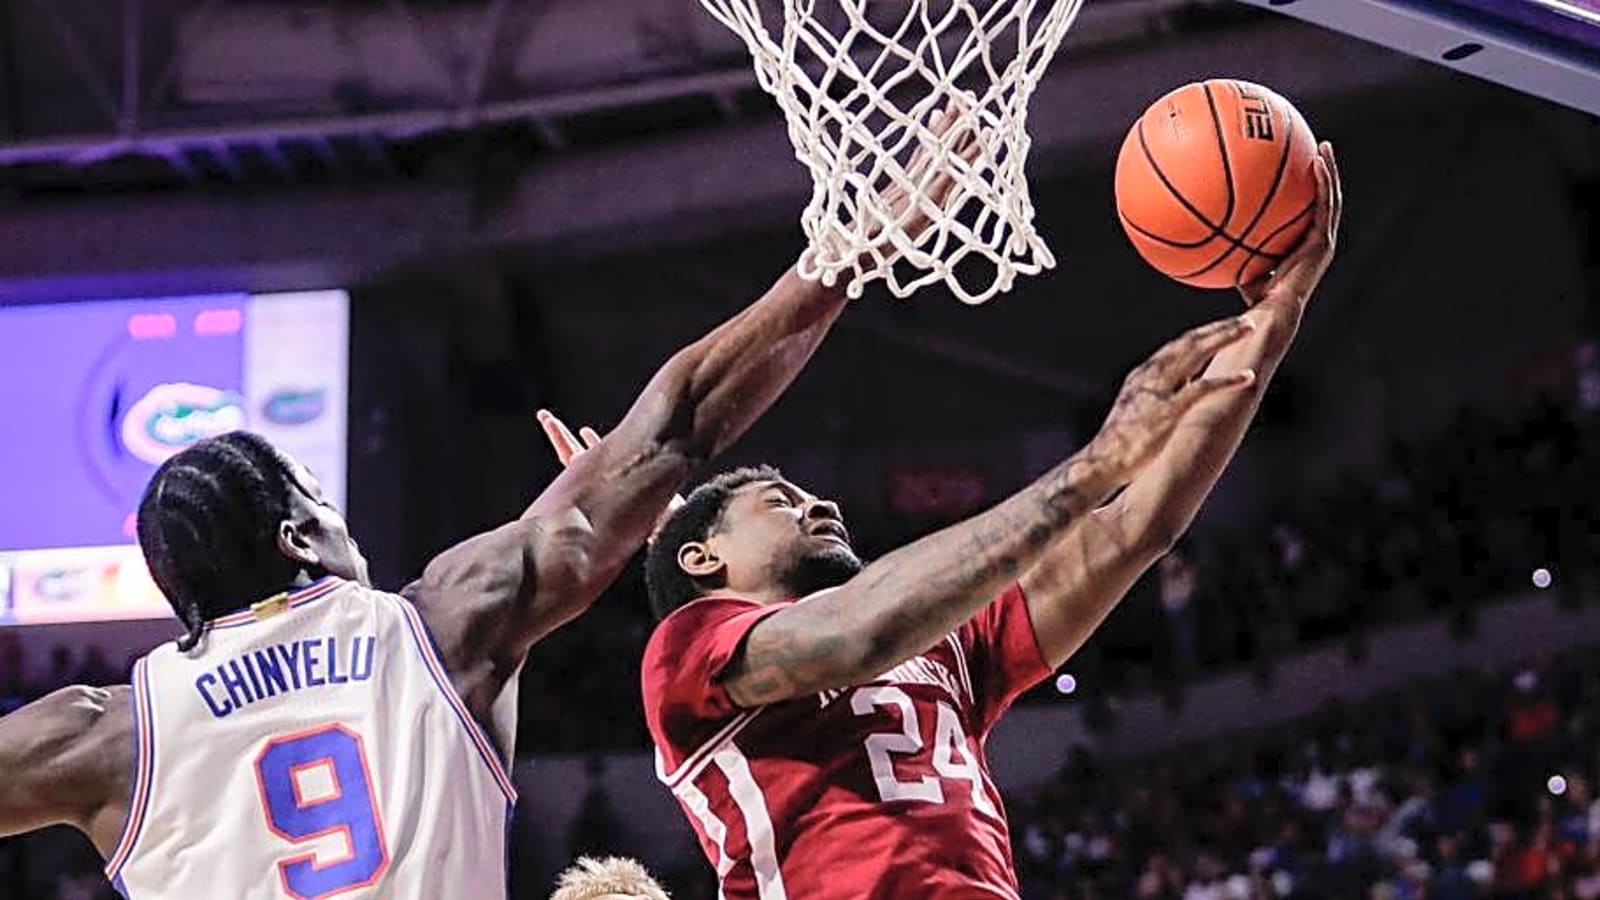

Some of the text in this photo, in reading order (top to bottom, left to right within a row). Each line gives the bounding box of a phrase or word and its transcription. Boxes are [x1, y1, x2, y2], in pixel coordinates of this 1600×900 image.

[195, 636, 376, 718] CHINYELU
[253, 722, 390, 900] 9
[851, 686, 1000, 819] 24
